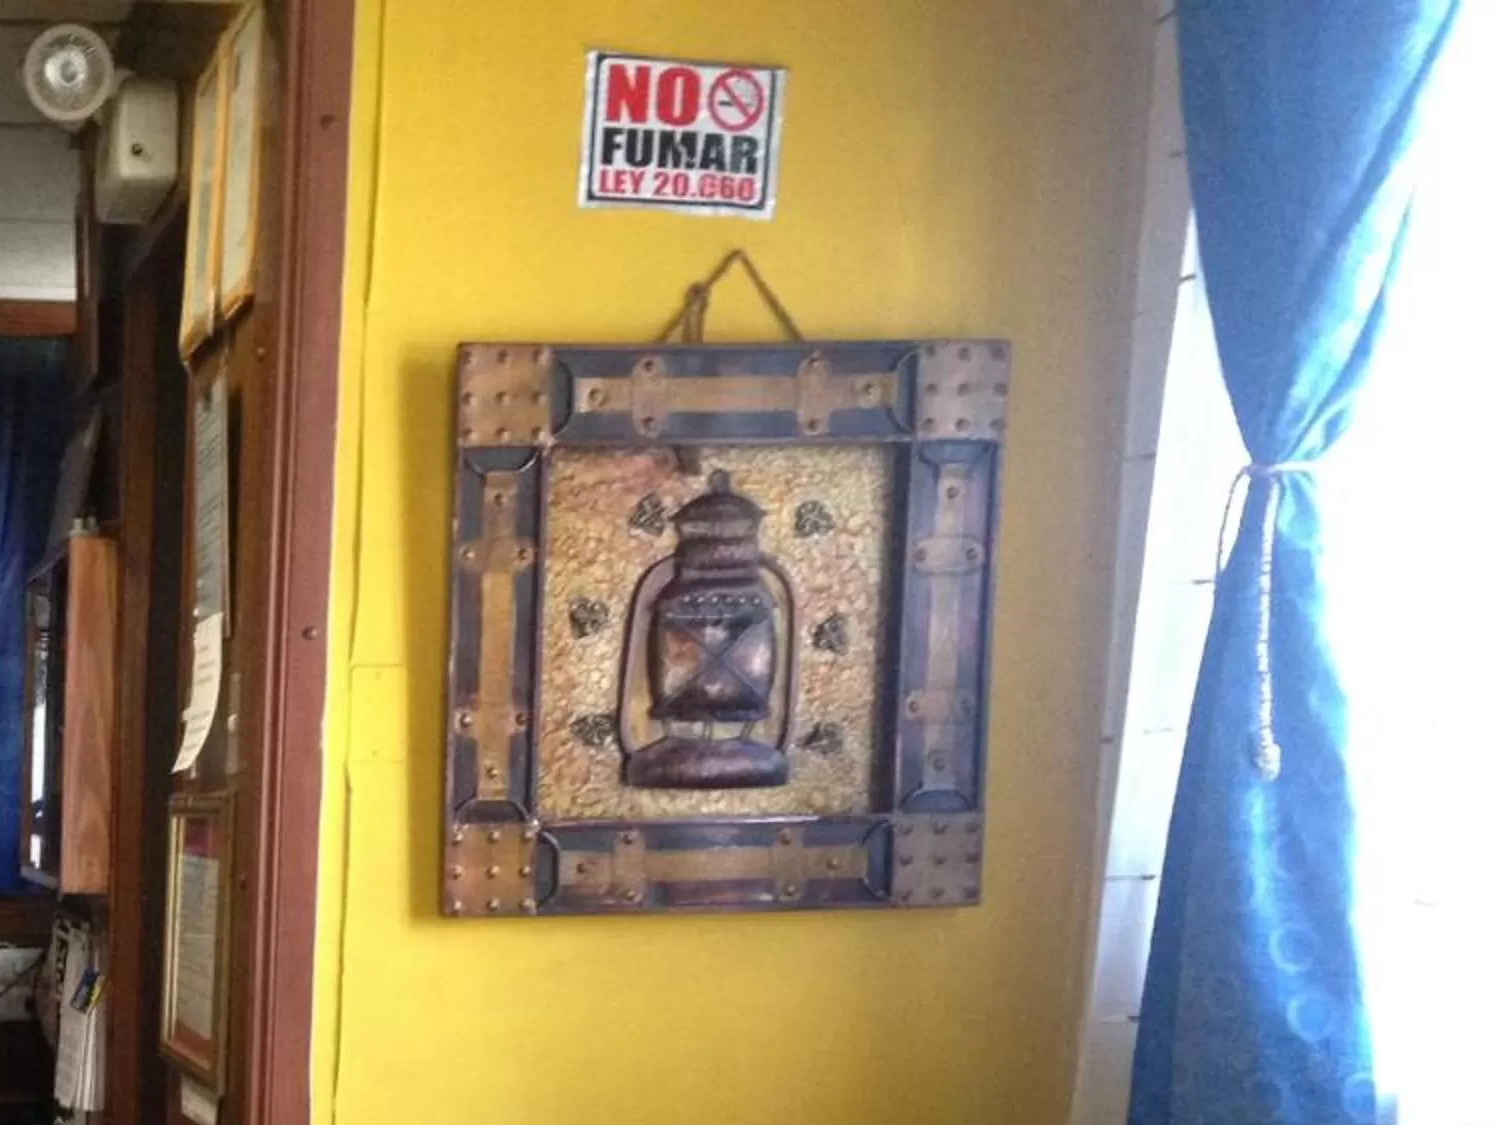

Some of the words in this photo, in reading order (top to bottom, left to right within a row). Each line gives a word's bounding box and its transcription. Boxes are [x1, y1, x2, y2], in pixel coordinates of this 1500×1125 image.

[605, 64, 701, 126] NO
[601, 128, 758, 174] FUMAR
[598, 168, 645, 194] LEY
